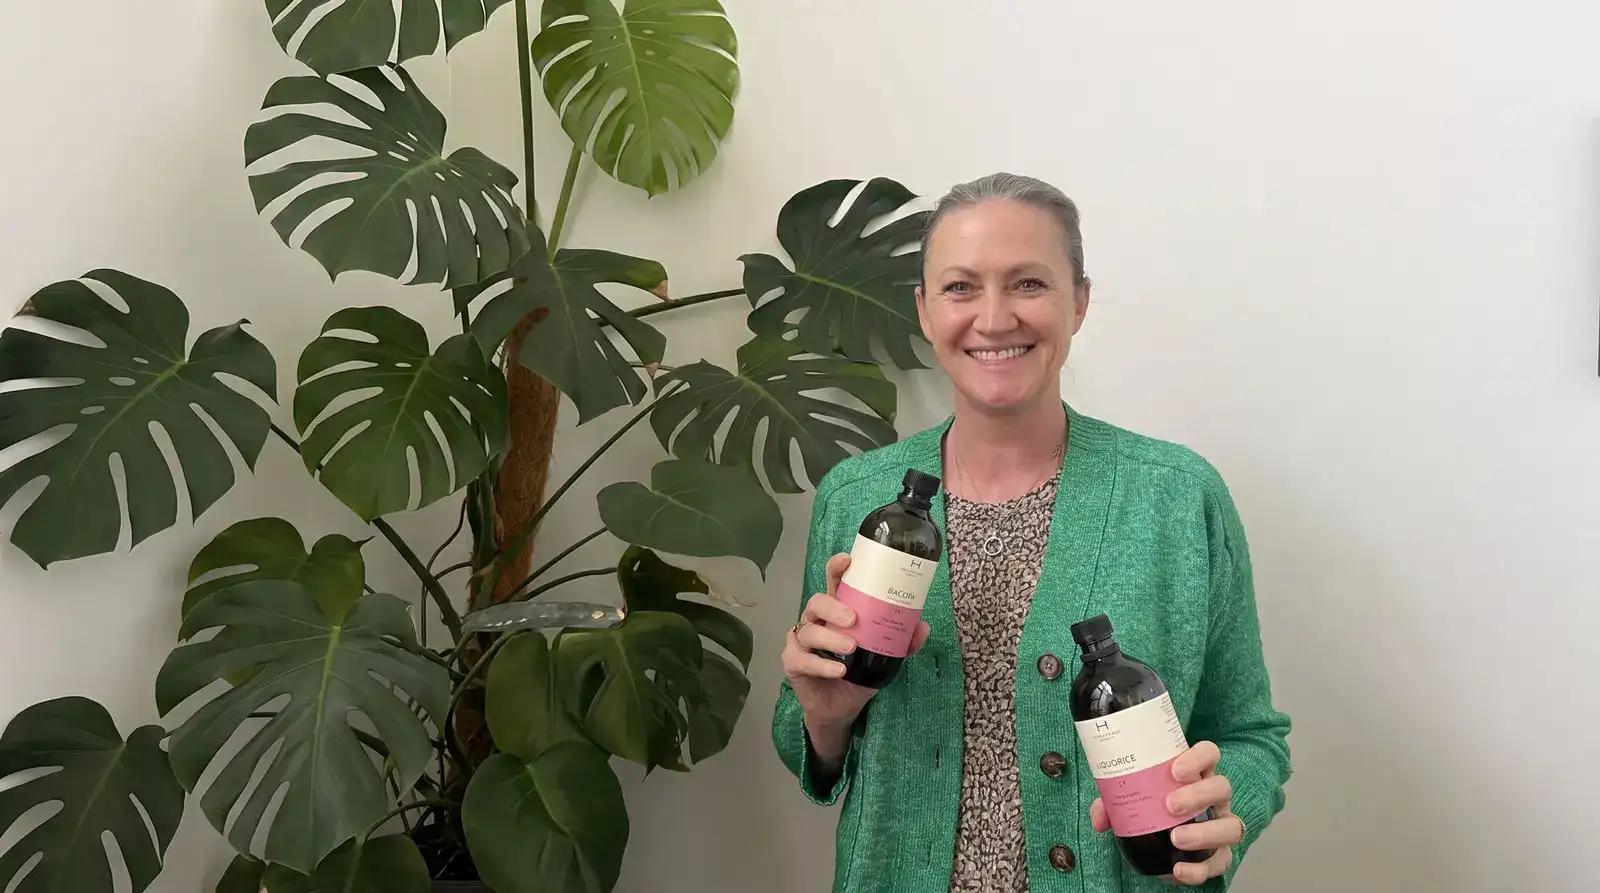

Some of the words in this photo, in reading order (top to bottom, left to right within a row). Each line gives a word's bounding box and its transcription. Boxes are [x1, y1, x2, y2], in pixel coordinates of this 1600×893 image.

[887, 587, 916, 601] BACOPA
[1095, 720, 1109, 733] H
[1096, 753, 1137, 770] LIQUORICE
